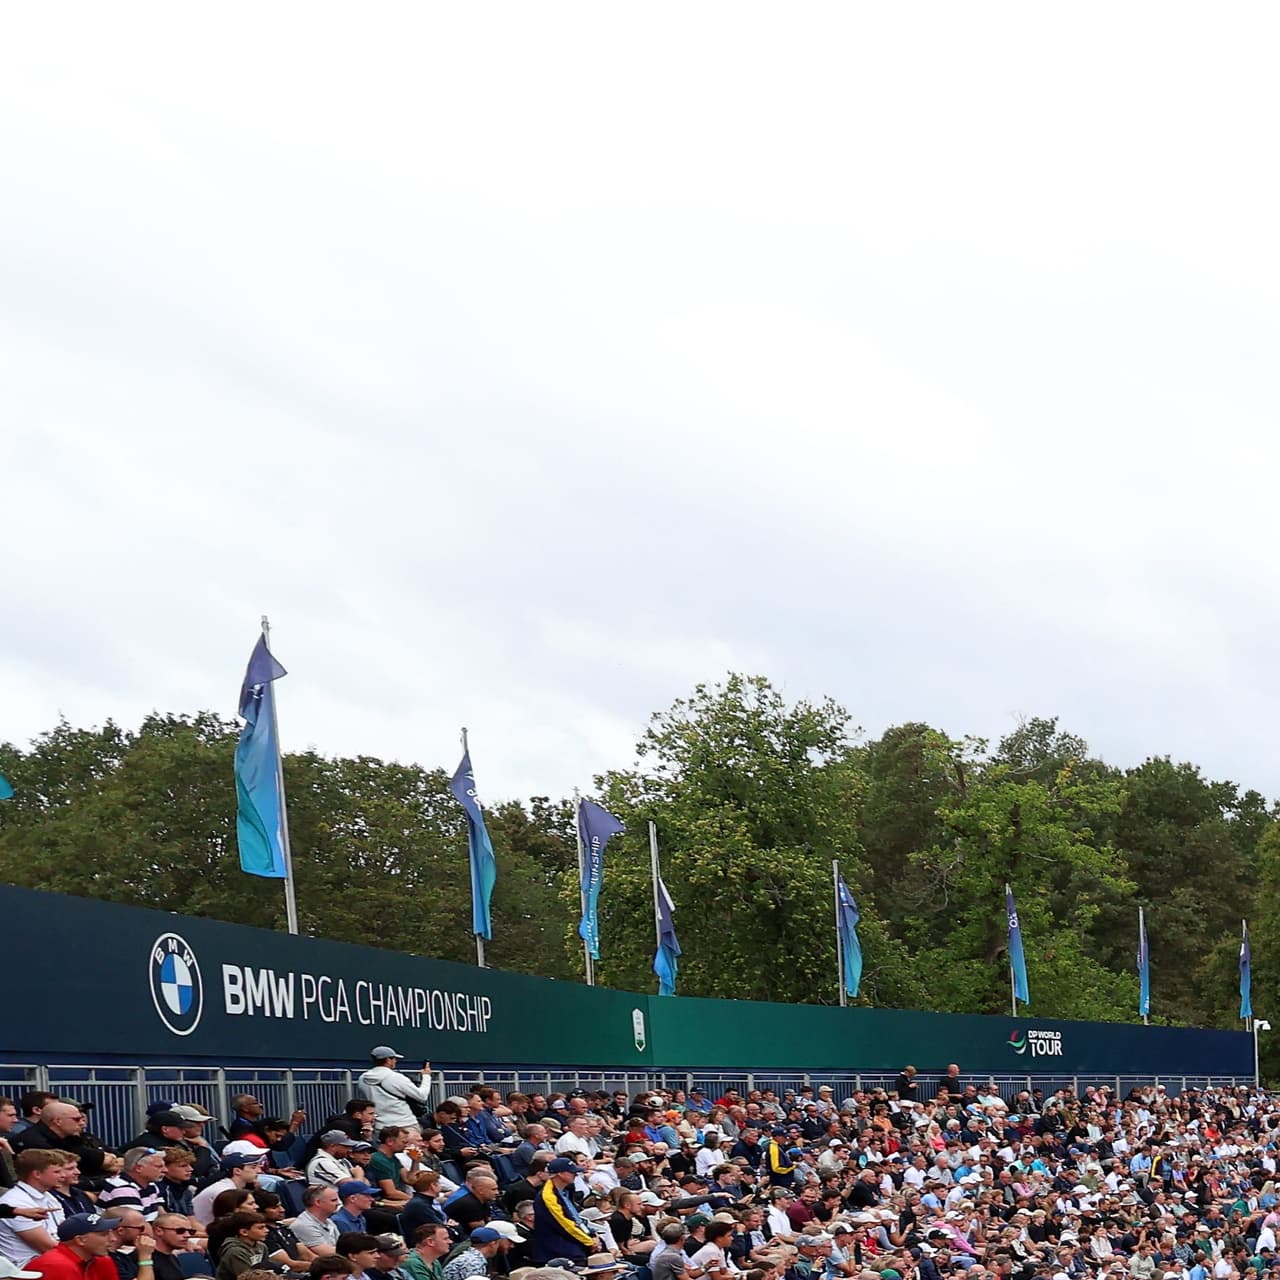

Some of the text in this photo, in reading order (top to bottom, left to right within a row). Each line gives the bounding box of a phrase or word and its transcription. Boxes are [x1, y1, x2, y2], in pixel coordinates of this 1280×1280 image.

[155, 939, 194, 967] BMW
[222, 964, 492, 1033] BMW PGA CHAMPIONSHIP
[1028, 1030, 1062, 1040] DP WORLD
[1028, 1039, 1063, 1058] TOUR
